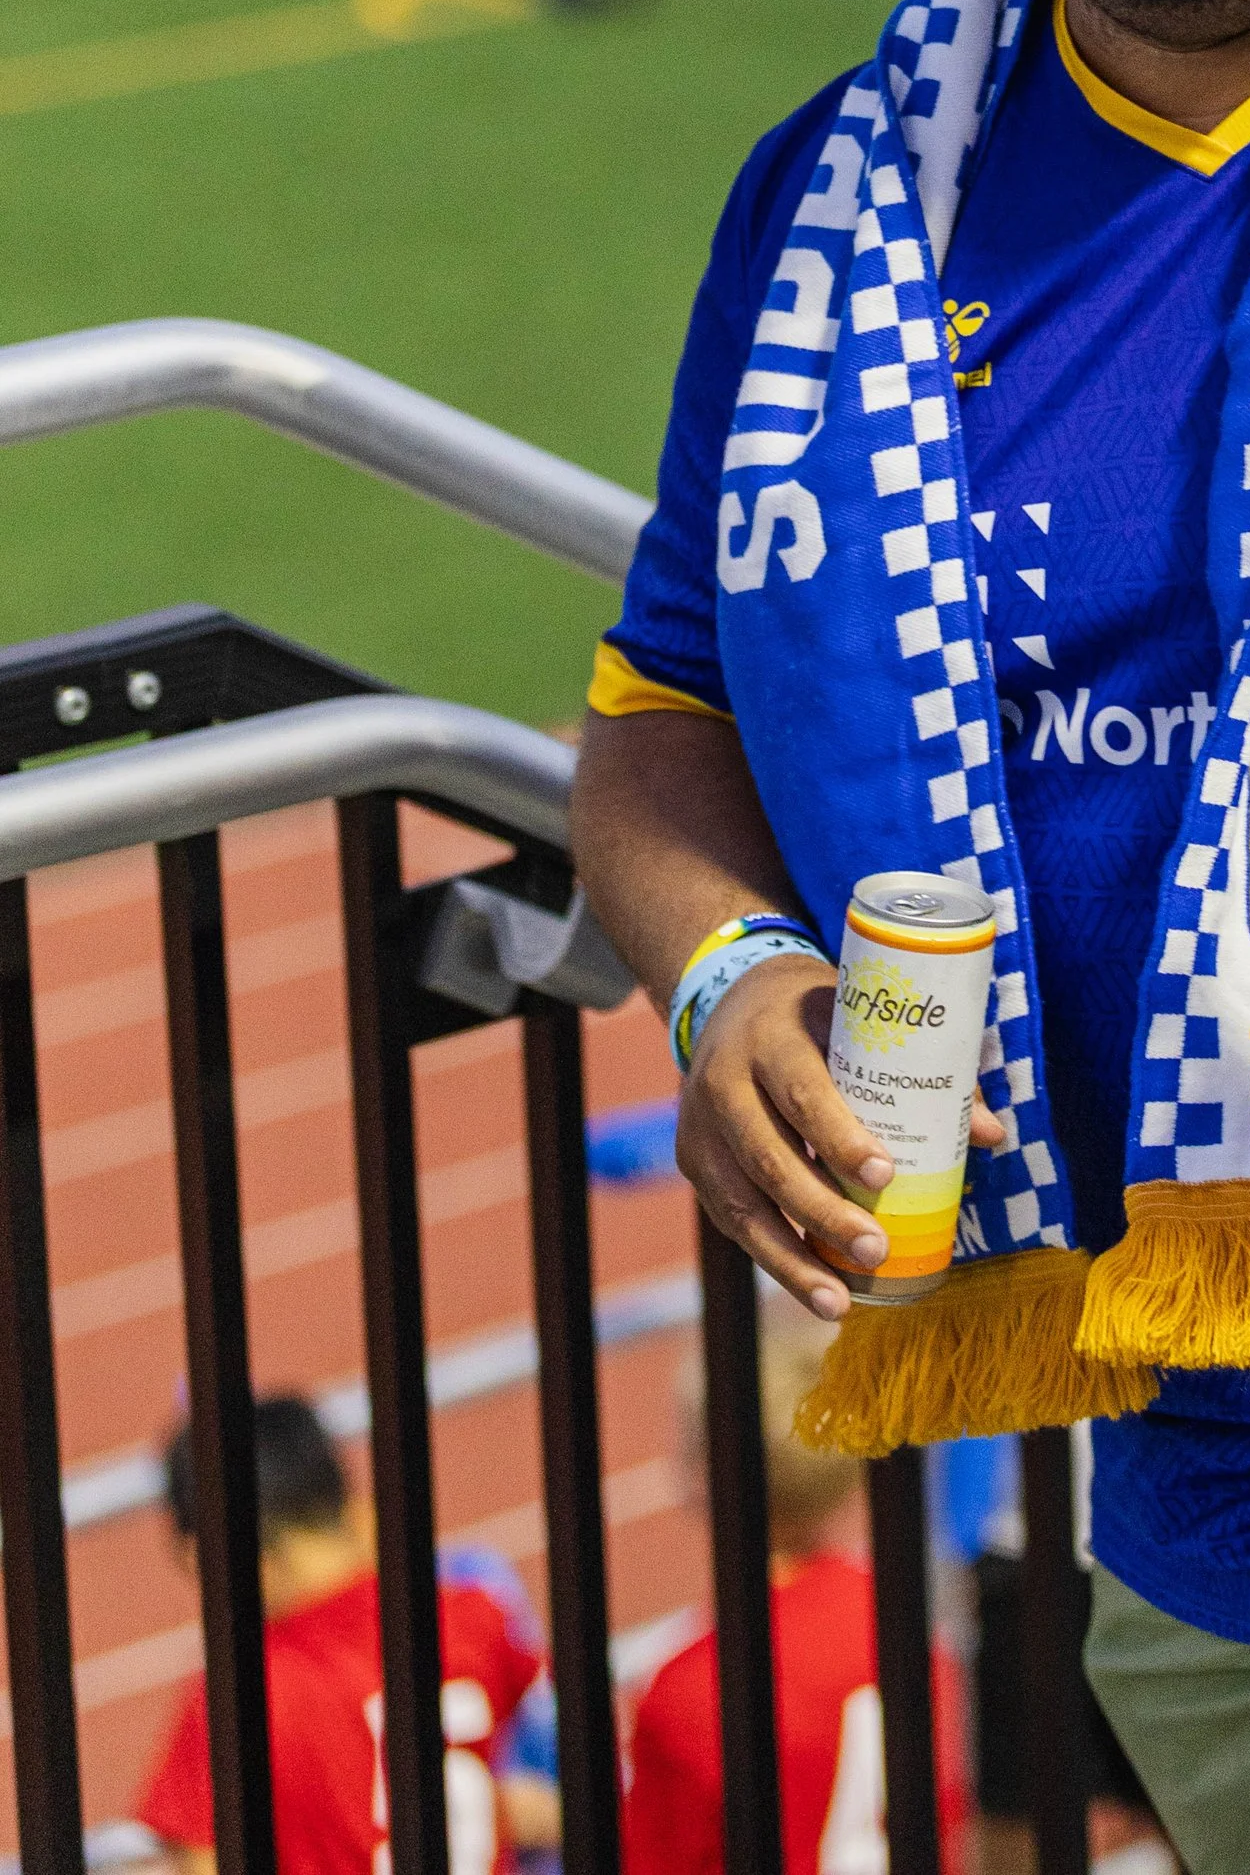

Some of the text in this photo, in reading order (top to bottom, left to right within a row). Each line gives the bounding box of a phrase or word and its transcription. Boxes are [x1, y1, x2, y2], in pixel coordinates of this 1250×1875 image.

[855, 1066, 864, 1079] &
[869, 1070, 954, 1090] LEMONADE
[845, 1080, 895, 1106] VODKA
